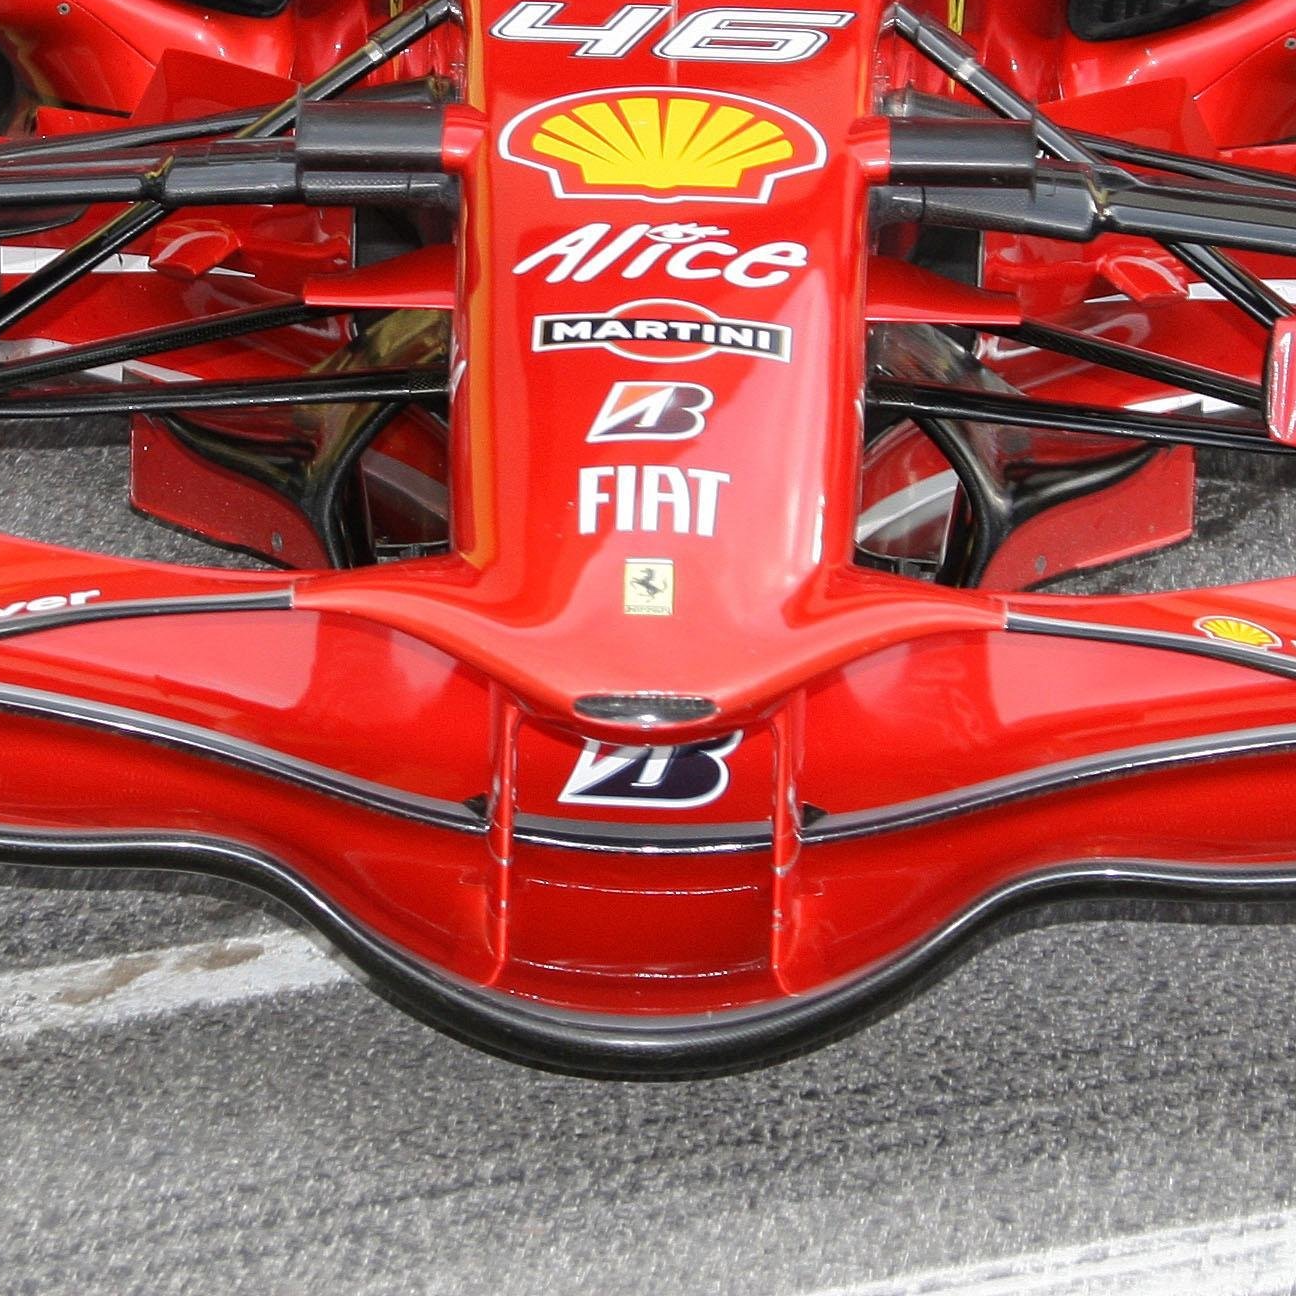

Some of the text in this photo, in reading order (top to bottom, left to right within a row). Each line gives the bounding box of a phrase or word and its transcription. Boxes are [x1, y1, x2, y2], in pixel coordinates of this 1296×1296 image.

[490, 0, 856, 63] 46
[512, 222, 808, 288] Alice
[551, 320, 771, 352] MARTINI
[578, 464, 731, 537] FIAT
